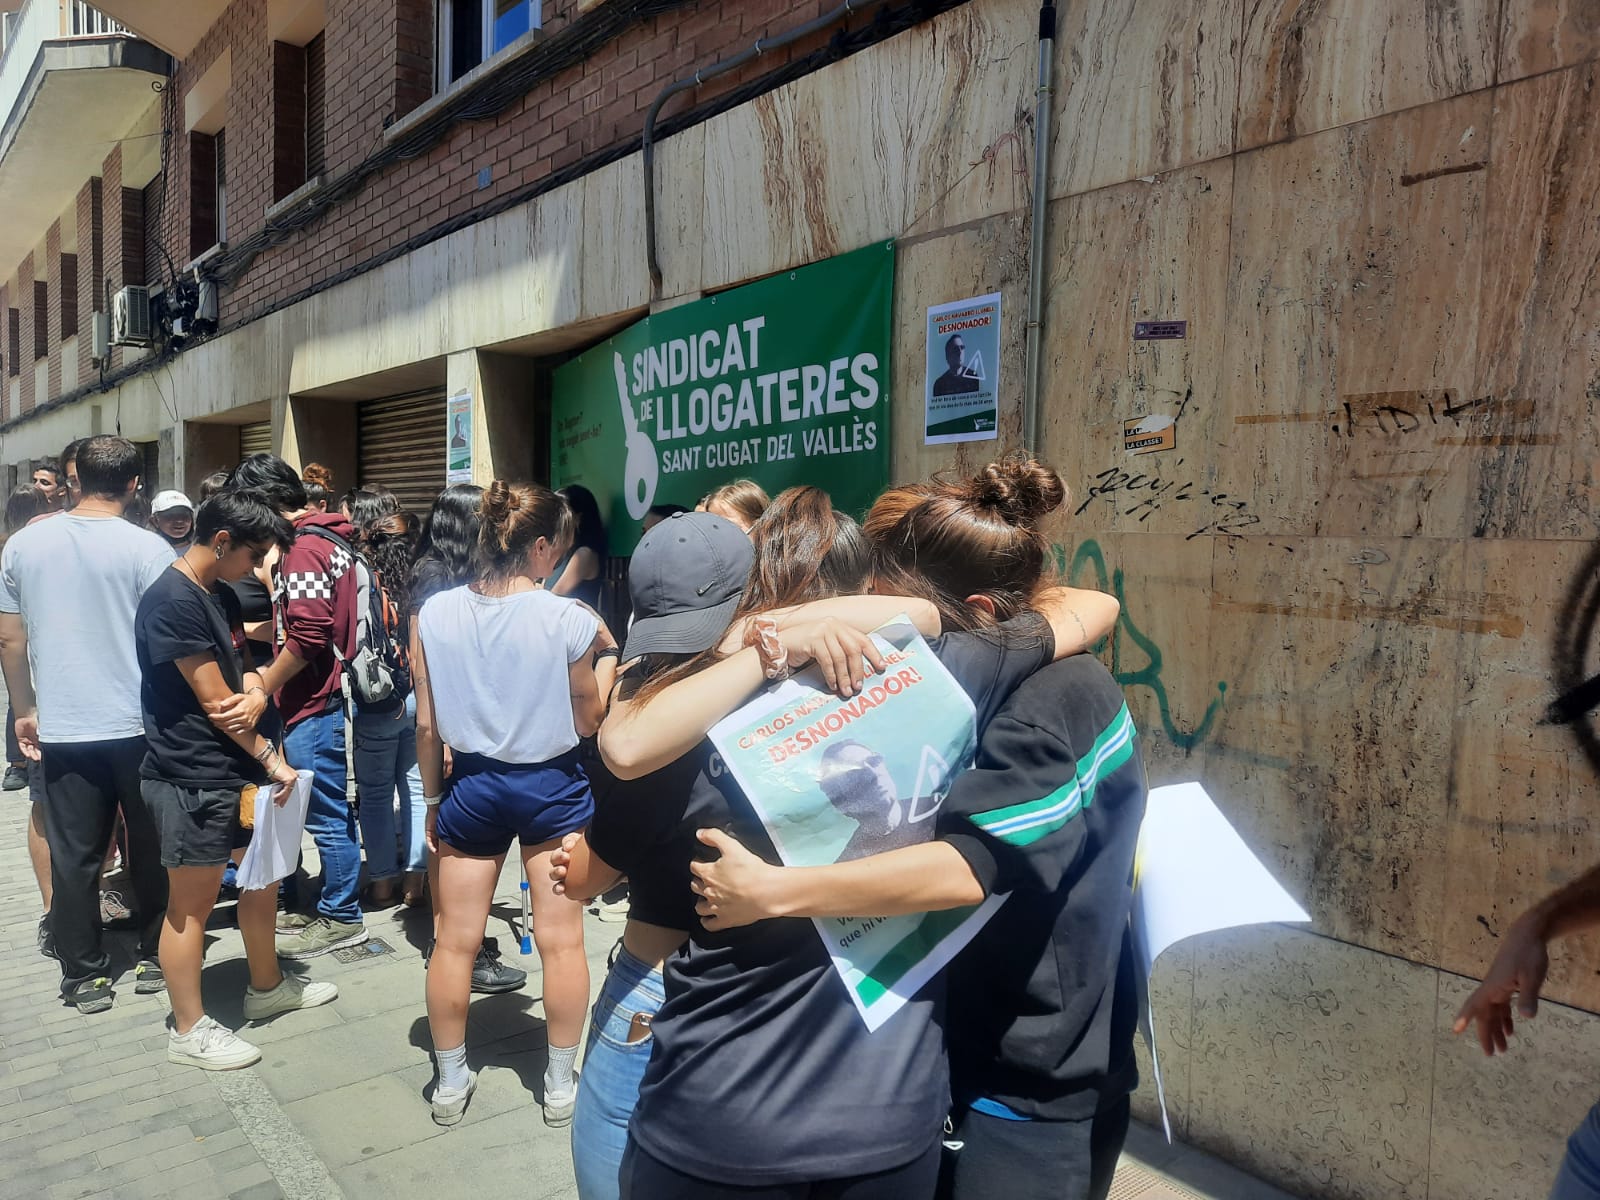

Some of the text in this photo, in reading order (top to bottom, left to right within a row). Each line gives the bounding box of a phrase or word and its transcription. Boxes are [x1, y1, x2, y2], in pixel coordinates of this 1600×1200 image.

[632, 315, 766, 396] SINDICAT
[938, 316, 992, 334] DESNONADOR!
[640, 398, 654, 422] DE
[656, 352, 879, 441] LLOGATERES
[662, 415, 877, 474] SANT CUGAT DEL VALLÈS
[768, 666, 923, 763] DESNONADOR!
[840, 929, 861, 948] que
